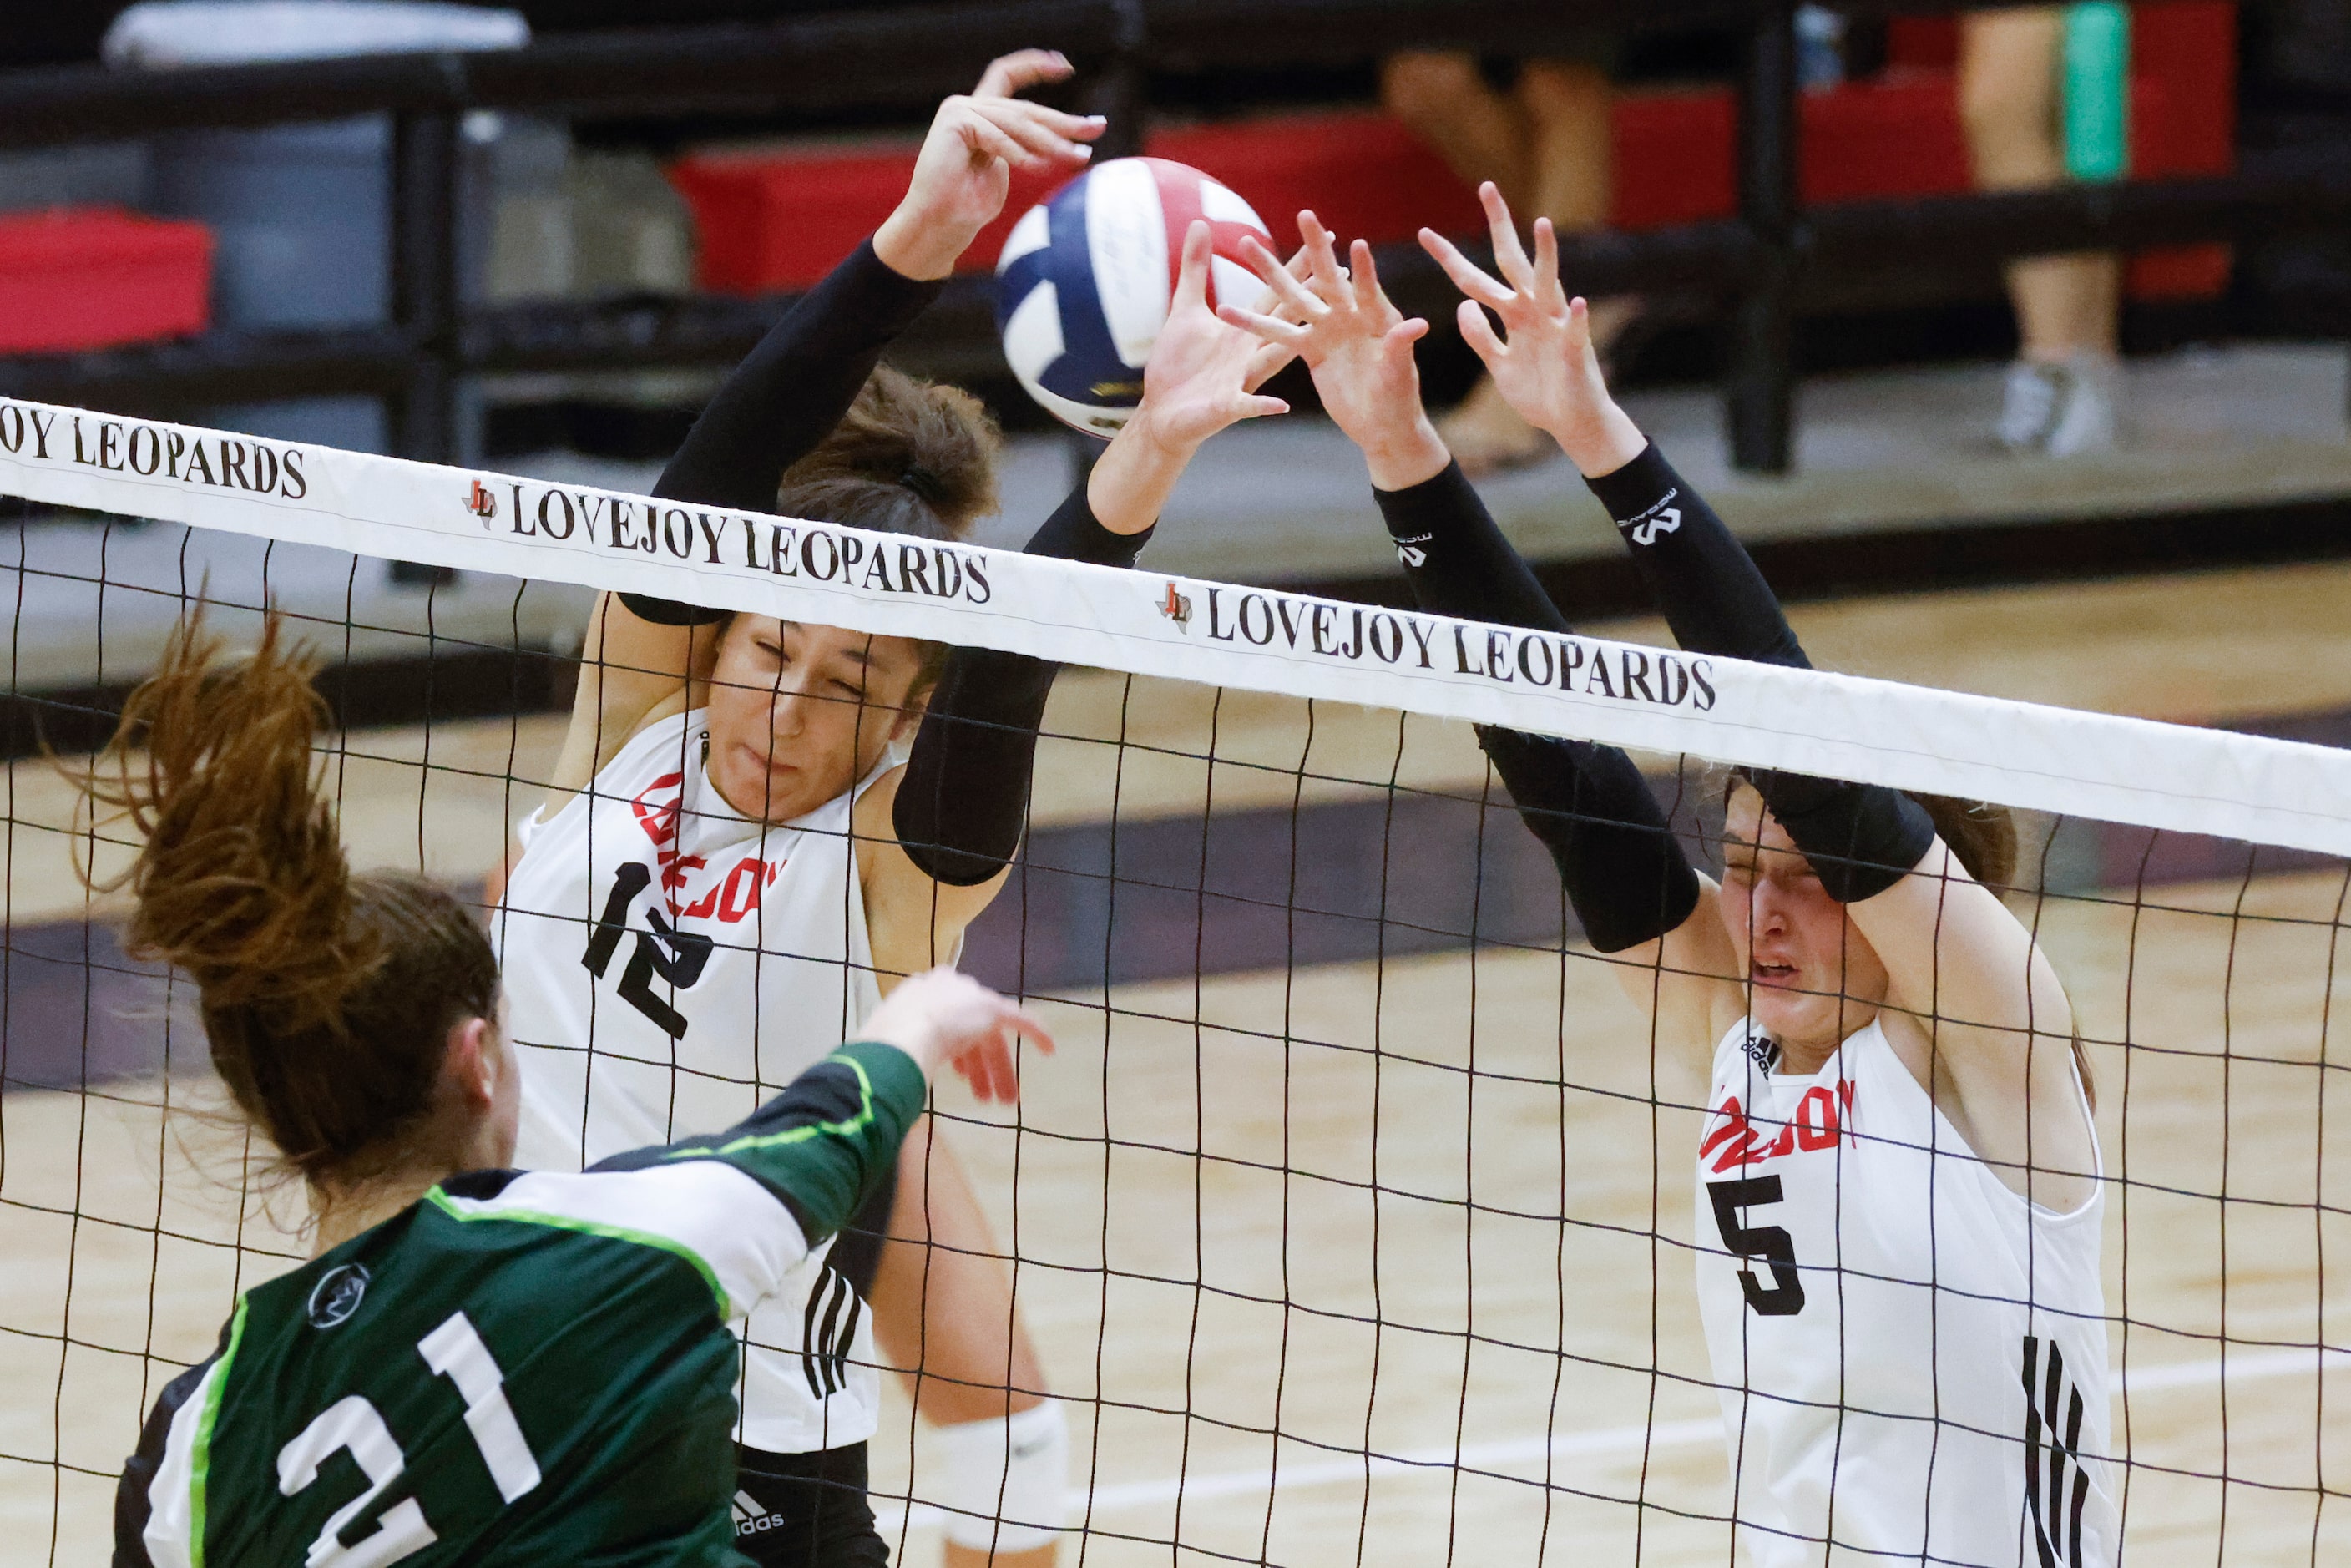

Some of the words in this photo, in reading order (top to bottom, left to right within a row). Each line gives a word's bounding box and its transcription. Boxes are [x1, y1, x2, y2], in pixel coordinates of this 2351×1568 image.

[72, 415, 306, 499] LEOPARDS
[508, 483, 731, 564] LOVEJOY
[741, 519, 991, 604] LEOPARDS
[1206, 587, 1438, 669] LOVEJOY
[1454, 625, 1716, 711] LEOPARDS
[581, 862, 715, 1041] 12
[1706, 1174, 1806, 1316] 5
[276, 1310, 543, 1568] 21
